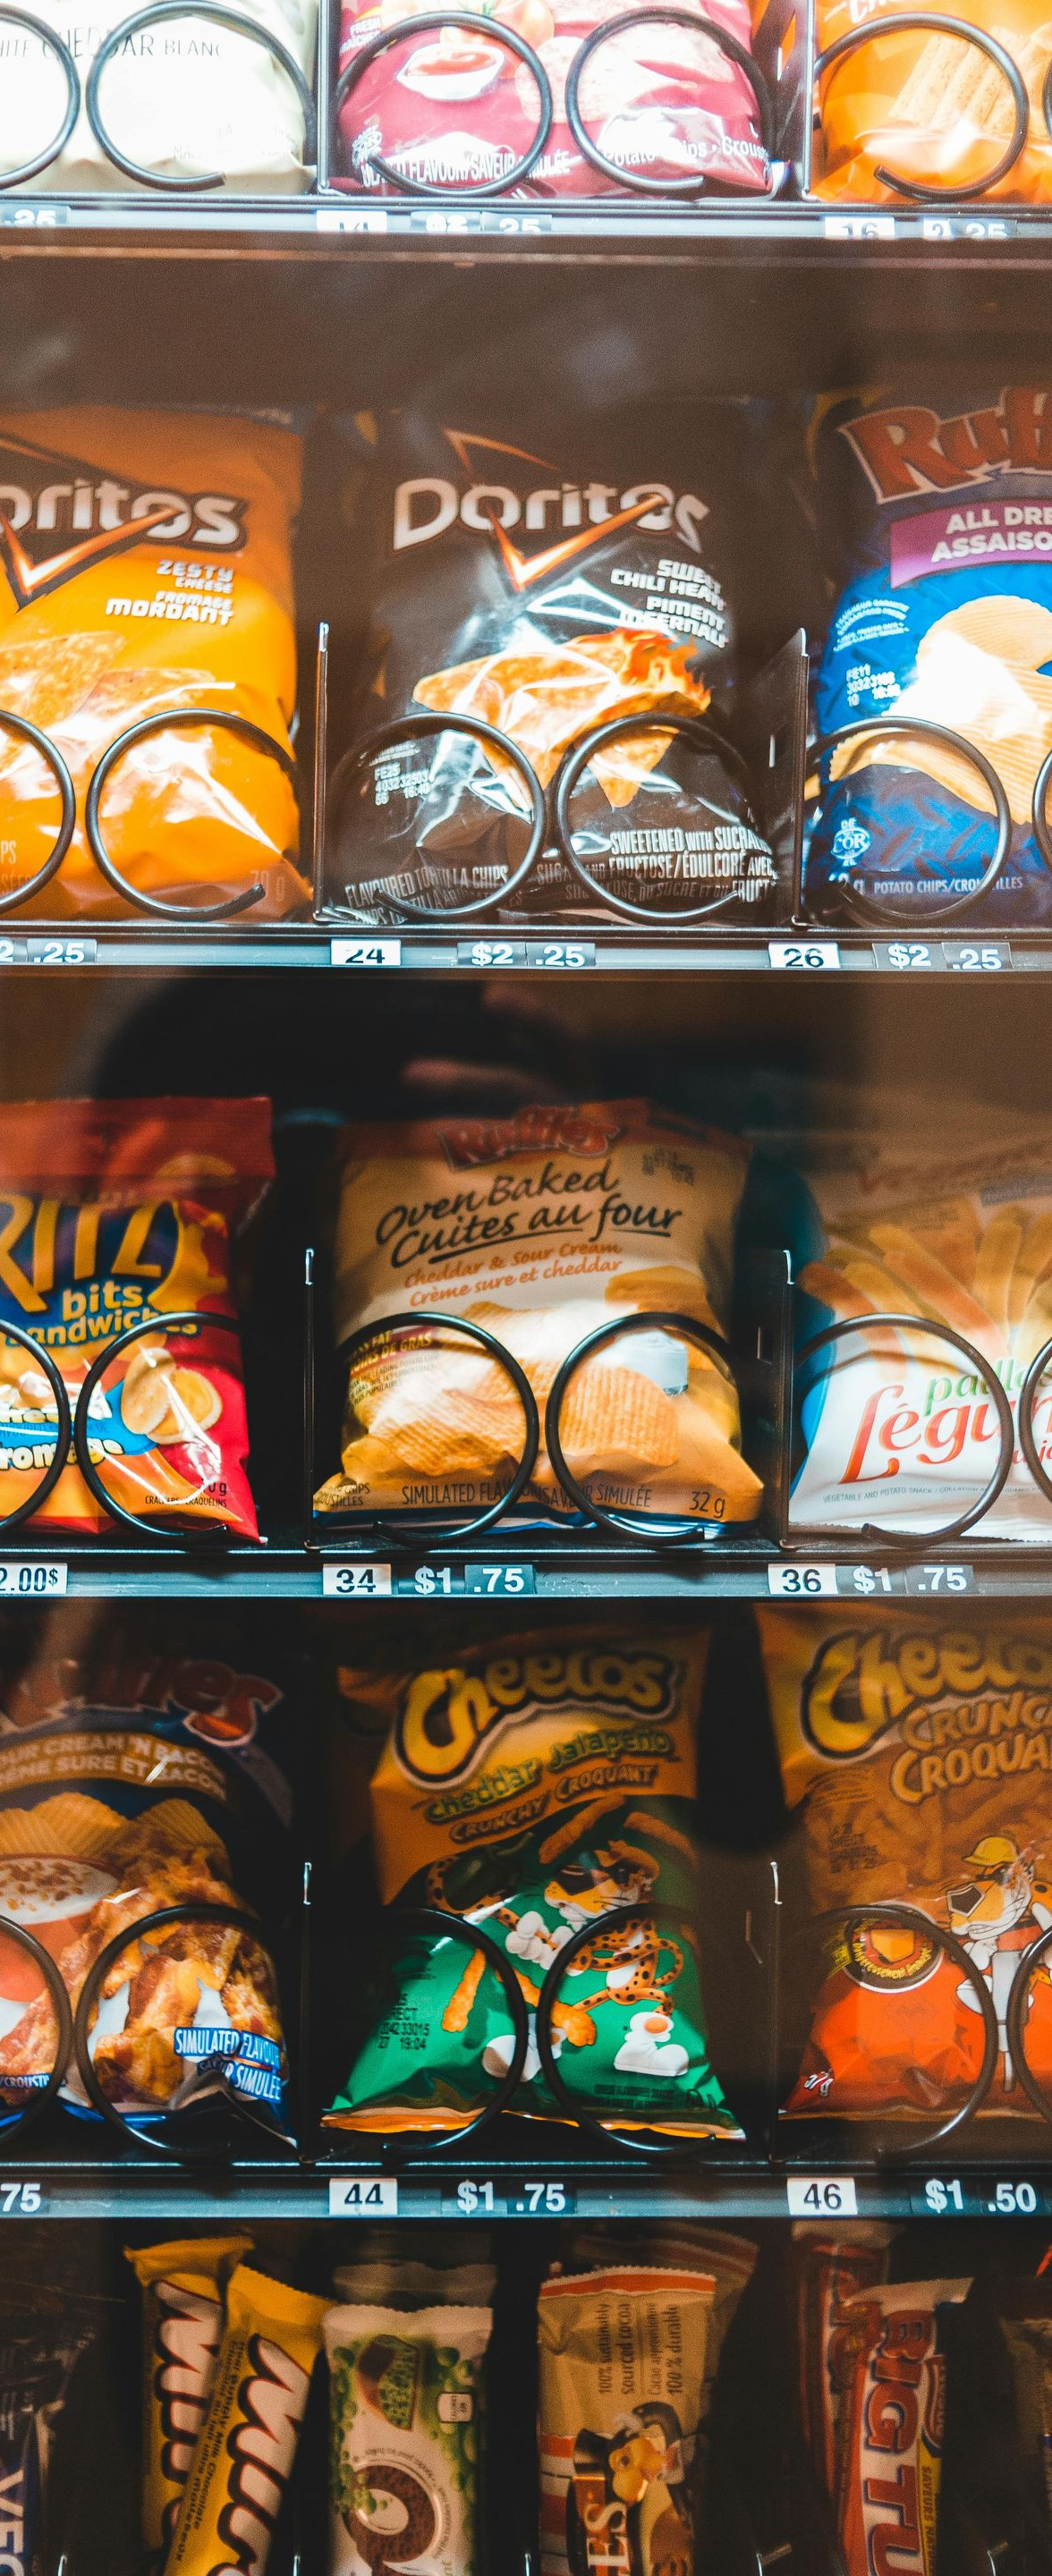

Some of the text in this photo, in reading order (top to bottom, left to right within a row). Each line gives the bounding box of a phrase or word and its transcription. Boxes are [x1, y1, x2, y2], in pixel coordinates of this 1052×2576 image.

[394, 477, 709, 553] Doritos
[946, 513, 1000, 536] ALL
[156, 558, 234, 583] ZESTY
[610, 568, 666, 593] CHILI
[174, 576, 233, 595] CHEESE
[105, 597, 235, 626] MORDANT
[155, 589, 234, 613] FROMAGE
[646, 595, 726, 631] PIMENT
[610, 826, 715, 855] SWEETENED WITH
[471, 863, 510, 890] CHIPS
[873, 880, 913, 894] POTATO
[33, 942, 85, 964] .25
[344, 942, 587, 968] 24 $2 .25
[784, 943, 1003, 970] 26 $2 .25
[375, 1188, 488, 1247] Oven
[487, 1159, 620, 1206] Baked
[389, 1192, 683, 1268] Cuites au four
[408, 1256, 623, 1309] Crème sure et cheddar
[62, 1280, 143, 1321] bits
[401, 1483, 475, 1504] SIMULATED
[597, 1484, 652, 1508] SIMULÉE
[688, 1491, 712, 1513] 32
[713, 1496, 726, 1519] g
[863, 1491, 879, 1503] AND
[879, 1487, 907, 1497] POTATO
[335, 1565, 526, 1596] 34 $1 .75
[782, 1564, 968, 1596] 36 $1 .75
[403, 1648, 669, 1776] Cheetos
[43, 1734, 126, 1756] CREAM
[54, 1754, 119, 1773] SURE
[120, 1755, 148, 1778] ET
[425, 1756, 544, 1824] Cheddar
[449, 1765, 659, 1843] CRUNCHY CROQUANT
[175, 2030, 240, 2056] SIMULATED
[343, 2182, 566, 2215] 44 $1 .75
[803, 2177, 1038, 2214] 46 $1 .50
